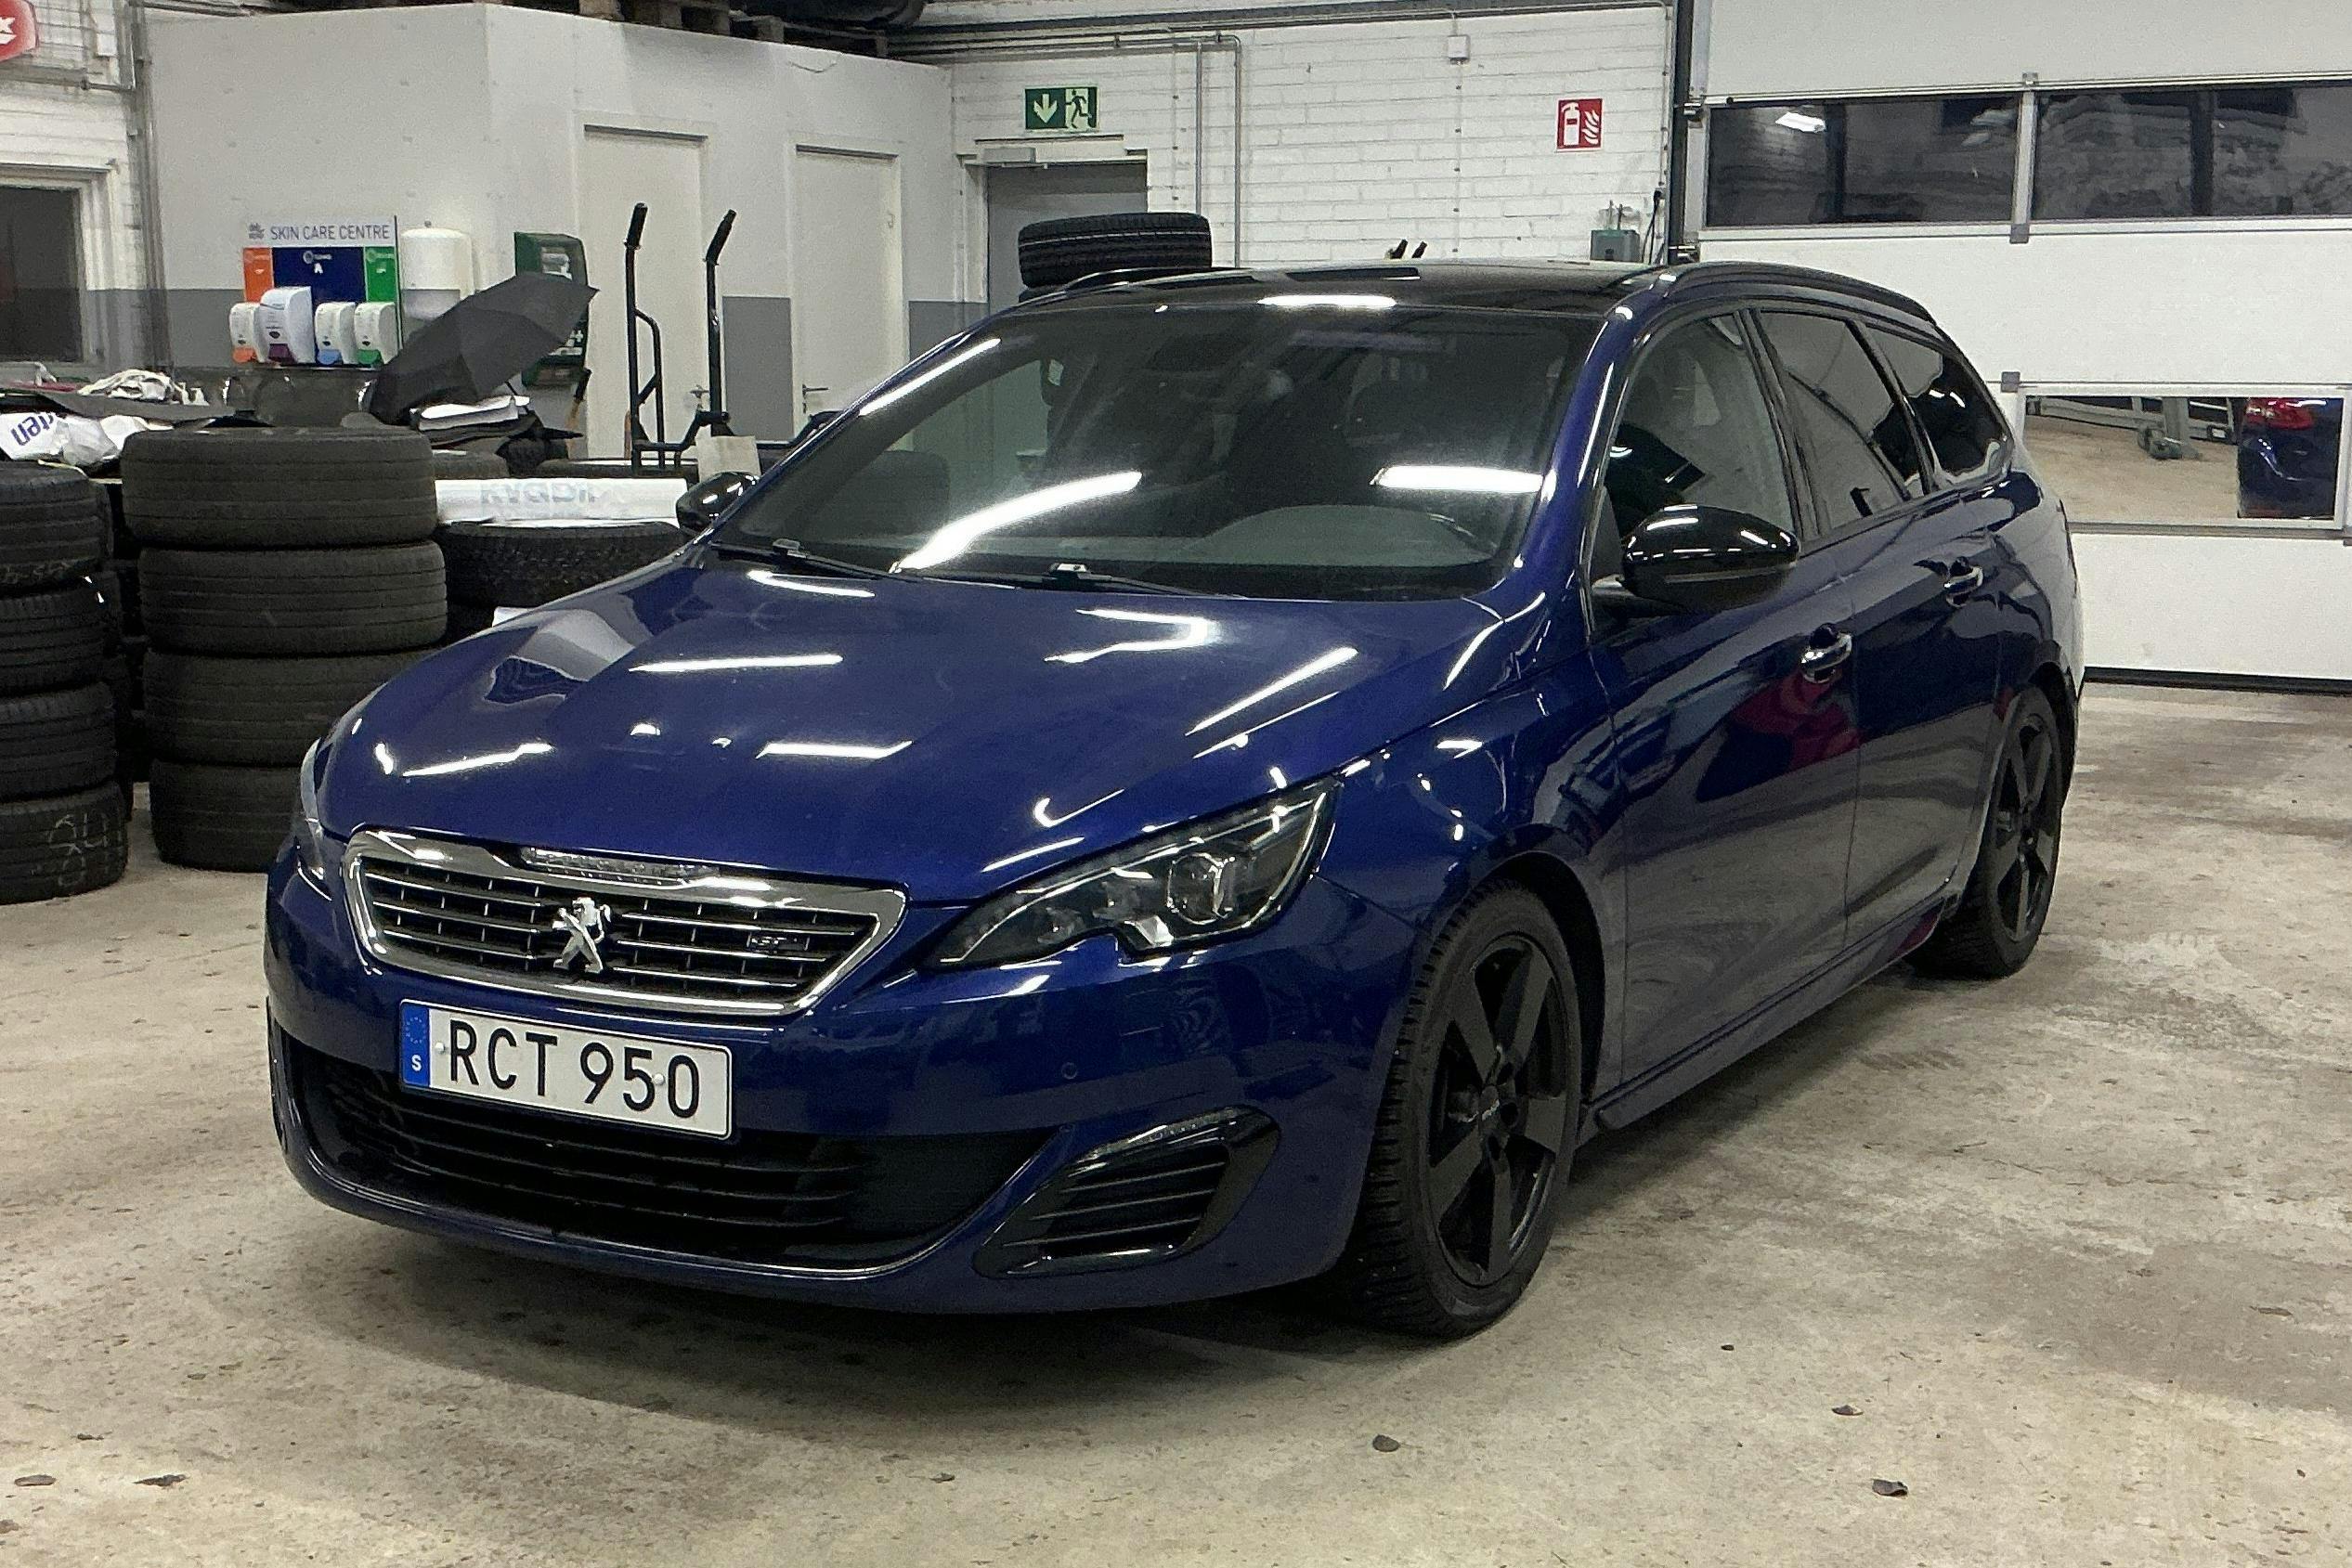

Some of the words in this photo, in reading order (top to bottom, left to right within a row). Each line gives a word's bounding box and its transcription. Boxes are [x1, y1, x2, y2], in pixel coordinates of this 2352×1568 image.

[270, 225, 299, 240] SKIN
[304, 225, 335, 240] CARE
[339, 225, 390, 240] CENTRE
[411, 1055, 422, 1071] S
[450, 1019, 558, 1096] RCT
[580, 1043, 699, 1118] 950
